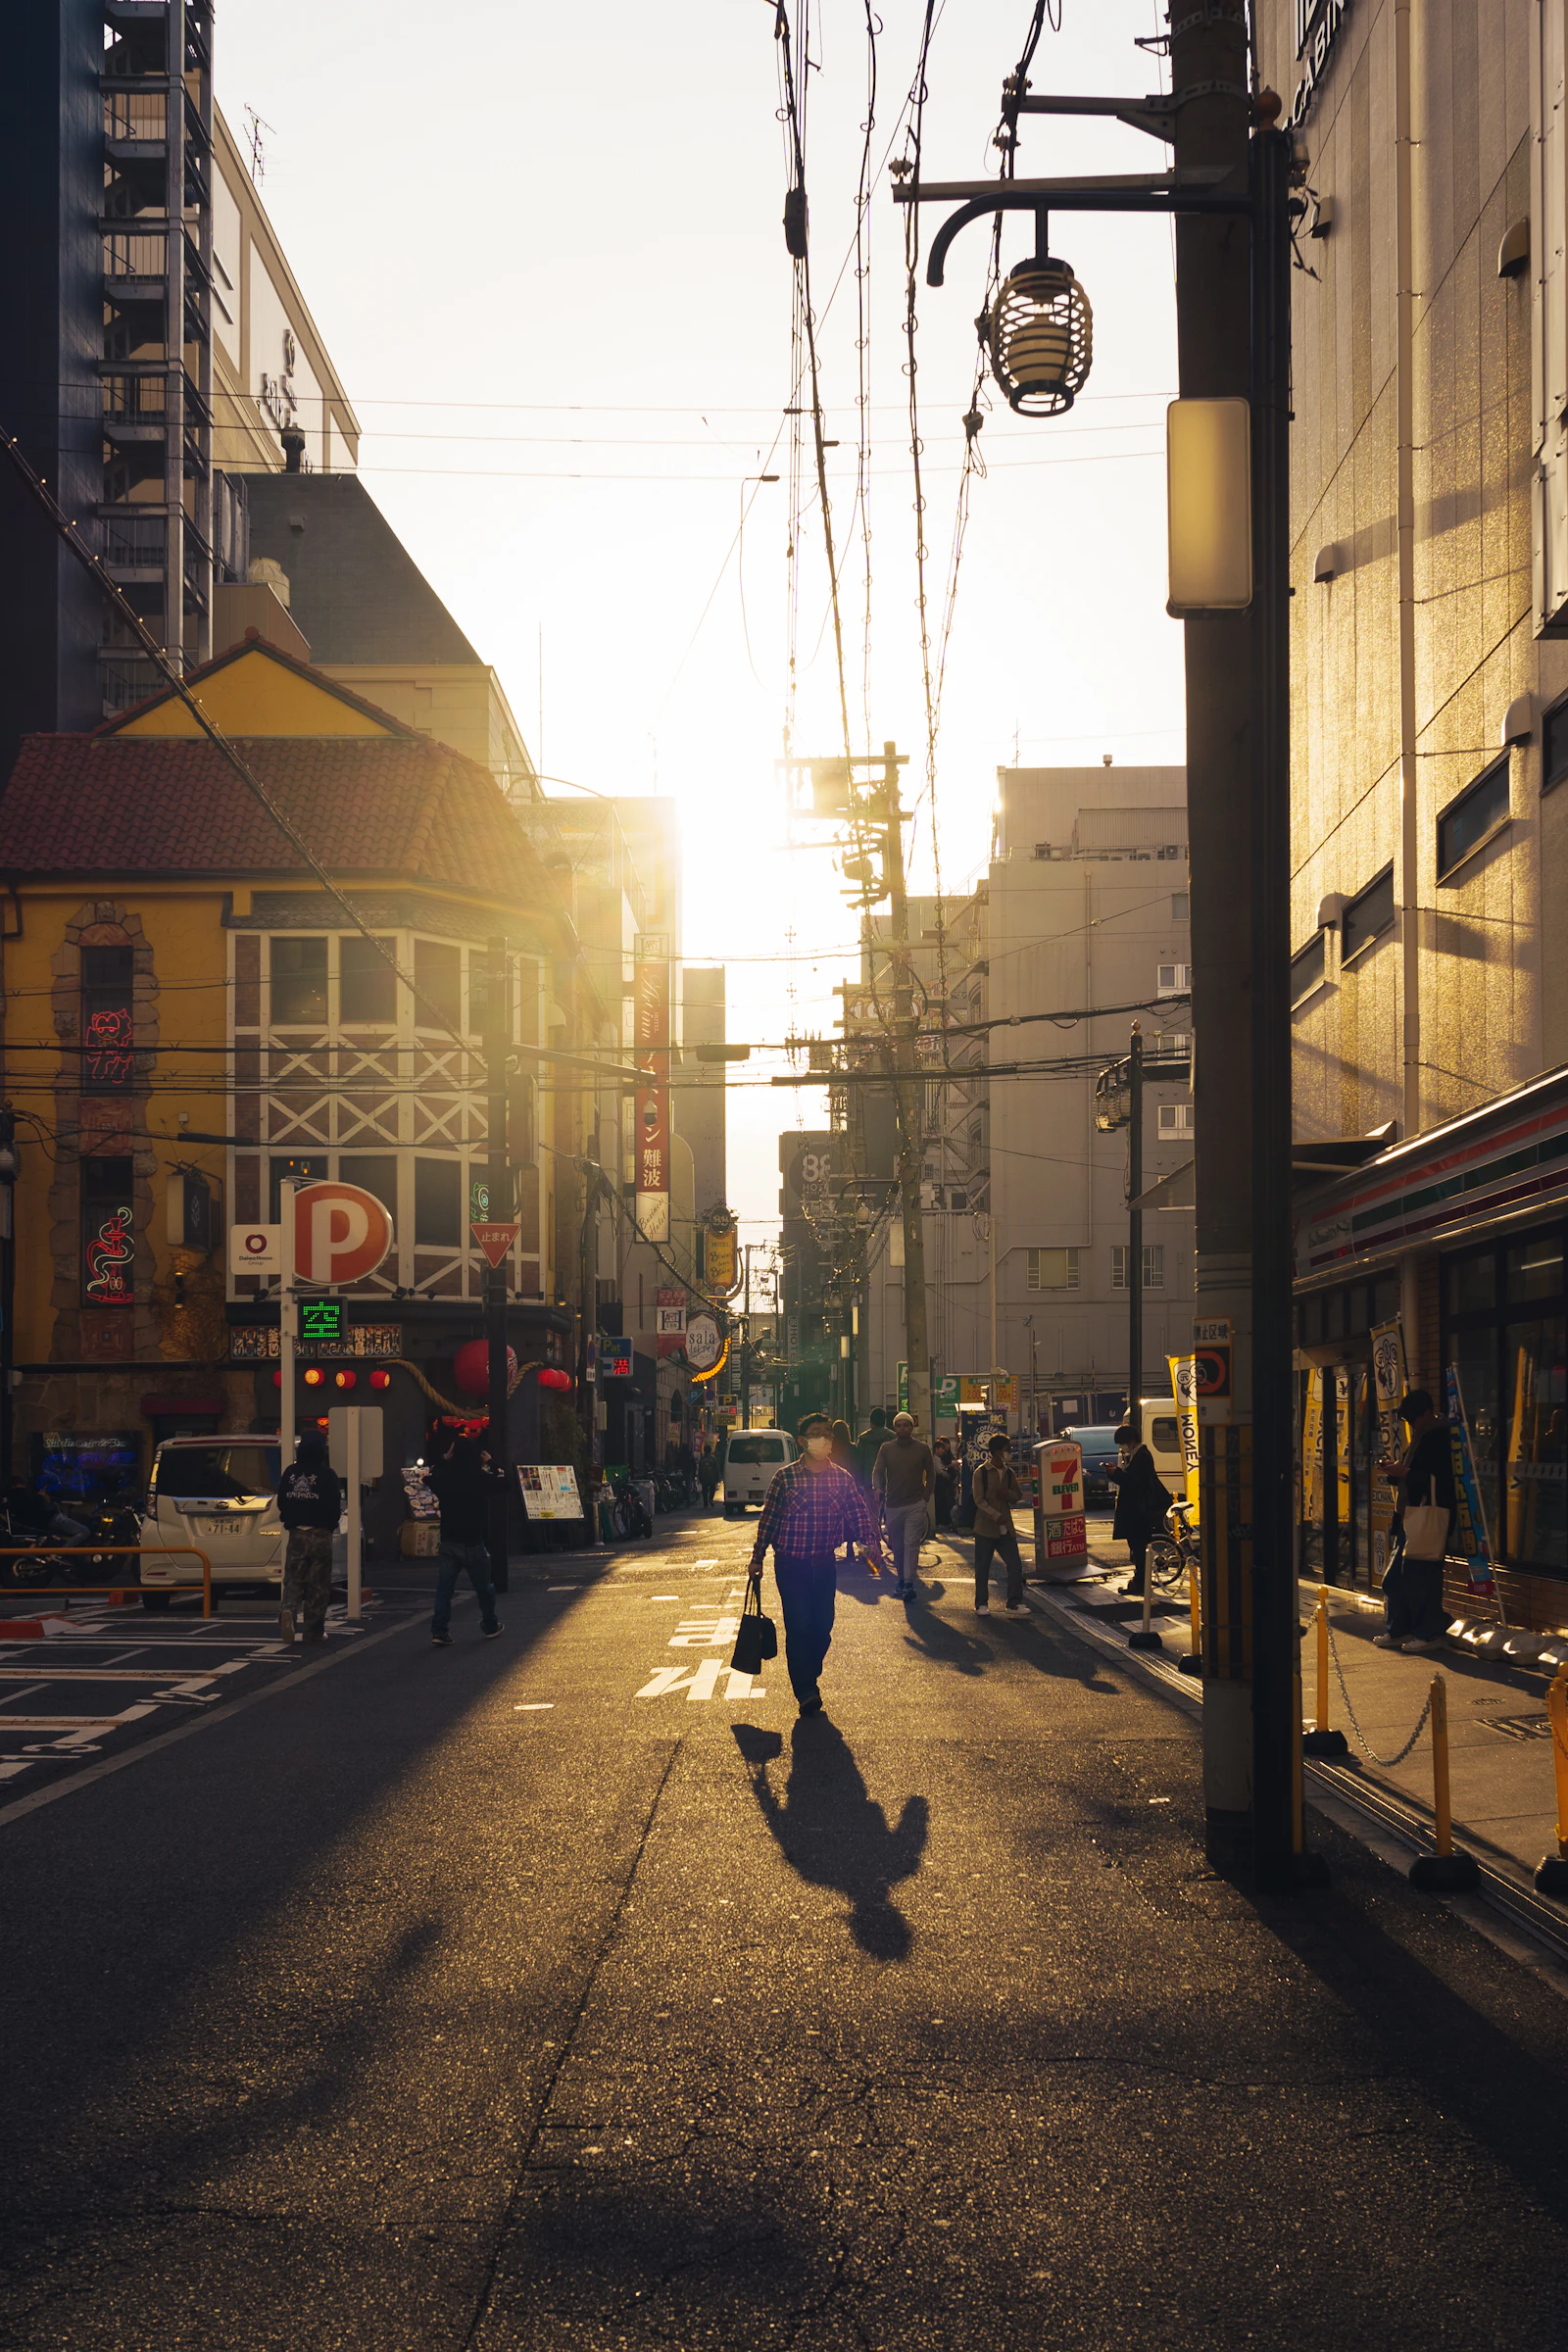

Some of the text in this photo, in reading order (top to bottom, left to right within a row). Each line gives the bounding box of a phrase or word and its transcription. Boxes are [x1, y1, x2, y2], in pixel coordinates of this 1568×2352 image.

[311, 1198, 368, 1283] P
[480, 1232, 511, 1243] 止まれ
[302, 1300, 340, 1339] 空
[689, 1330, 715, 1344] sala
[604, 1340, 621, 1352] Pat
[613, 1358, 629, 1374] 満
[723, 1396, 732, 1405] P
[1048, 1520, 1084, 1539] 酒 たばこ
